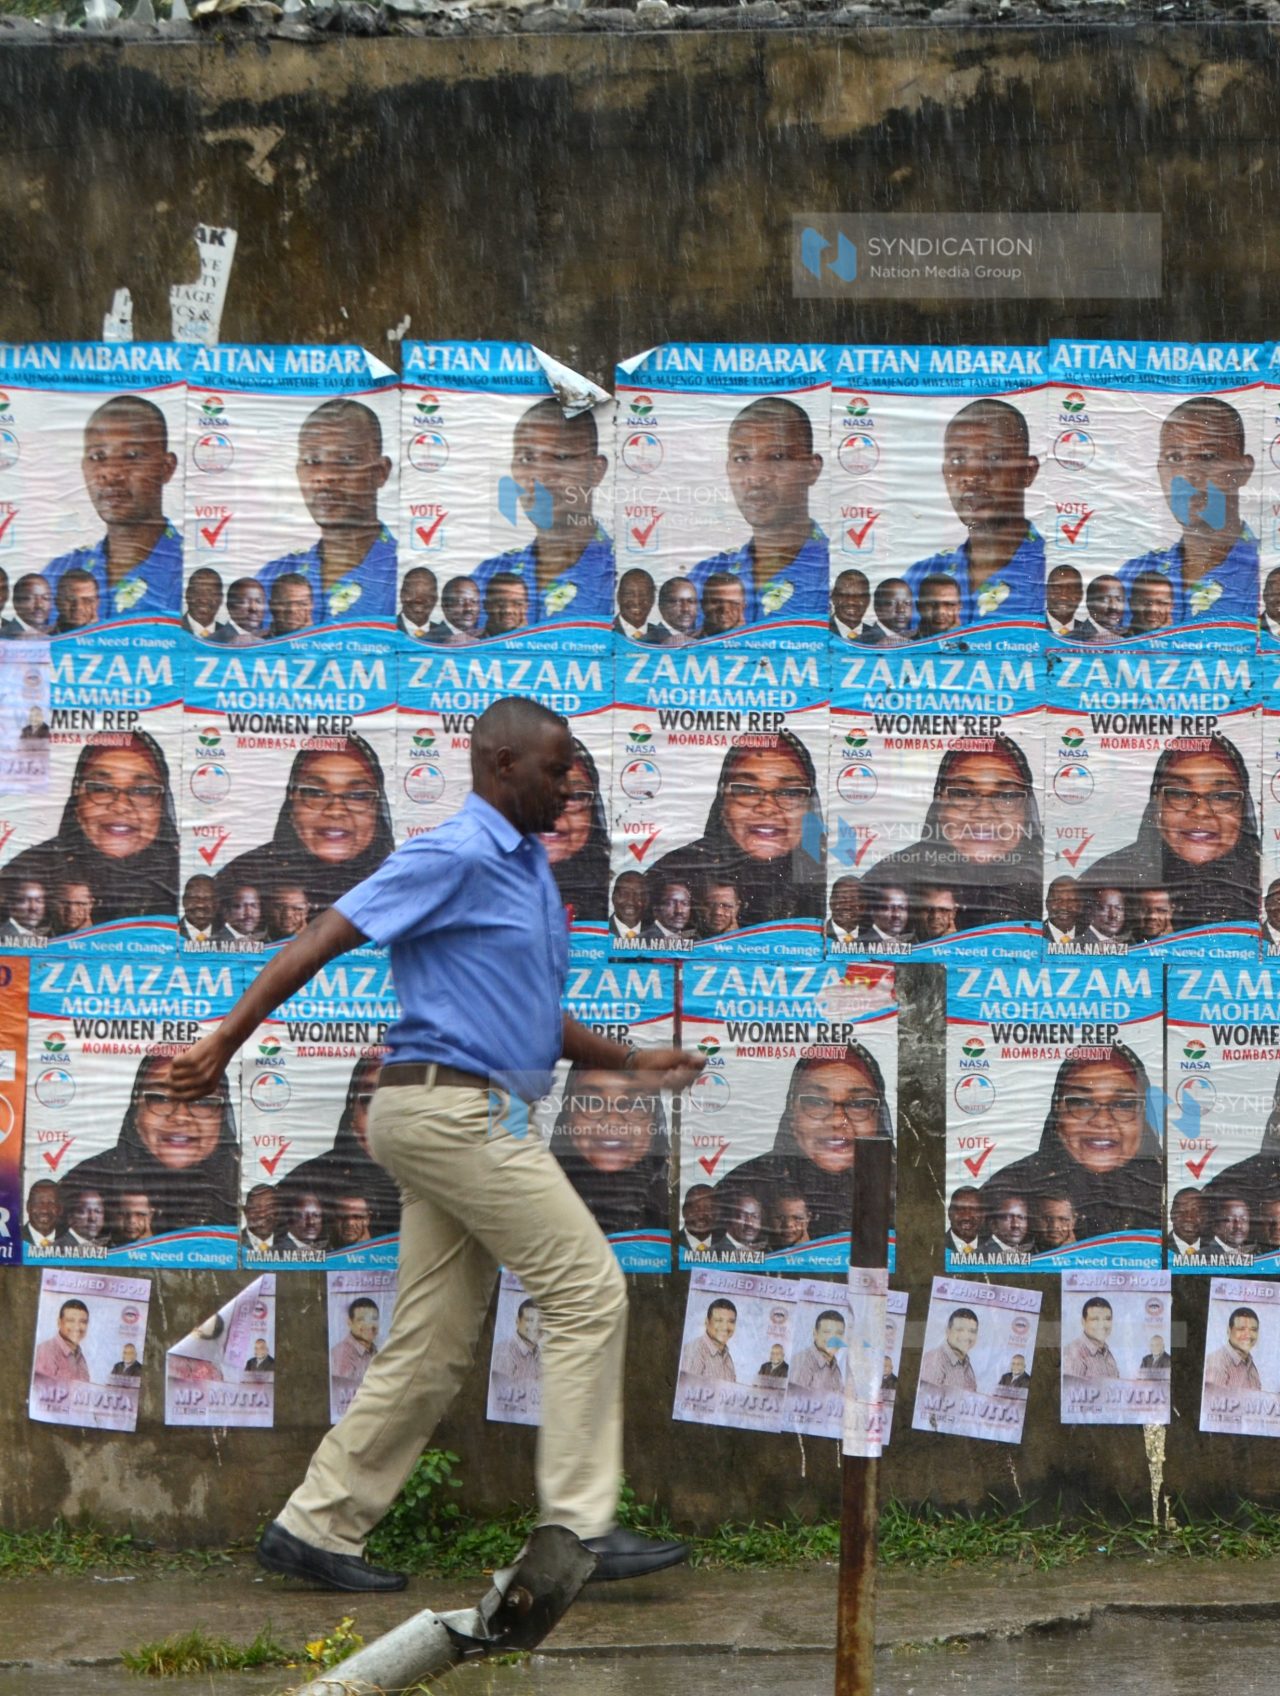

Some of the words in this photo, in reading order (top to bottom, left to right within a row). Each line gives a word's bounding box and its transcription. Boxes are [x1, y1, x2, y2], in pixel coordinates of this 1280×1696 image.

[70, 347, 183, 371] MBARAK
[192, 348, 275, 373] ATTAN
[407, 346, 490, 371] ATTAN
[714, 348, 827, 372] MBARAK
[836, 349, 919, 374] ATTAN
[930, 350, 1043, 374] MBARAK
[1053, 344, 1136, 369] ATTAN
[1147, 348, 1260, 372] MBARAK
[413, 416, 444, 424] NASA
[195, 506, 226, 517] VOTE
[192, 657, 387, 691] ZAMZAM
[624, 653, 819, 687] ZAMZAM
[840, 657, 1035, 691] ZAMZAM
[214, 690, 365, 710] MOHAMMED
[646, 687, 797, 707] MOHAMMED
[862, 692, 1013, 712] MOHAMMED
[227, 713, 309, 734] WOMEN
[317, 714, 357, 736] REP.
[658, 709, 740, 730] WOMEN
[749, 711, 789, 733] REP.
[1090, 713, 1172, 734] WOMEN
[1182, 715, 1222, 737] REP.
[626, 745, 656, 753] NASA
[668, 733, 727, 745] MOMBASA
[732, 735, 779, 747] COUNTY
[1101, 737, 1160, 749] MOMBASA
[1165, 739, 1212, 751] COUNTY
[624, 823, 655, 834] VOTE
[932, 948, 951, 957] We
[955, 948, 988, 957] Need
[992, 948, 1038, 958] Change
[38, 963, 233, 997] ZAMZAM
[956, 966, 1151, 1000] ZAMZAM
[60, 996, 211, 1016] MOHAMMED
[979, 1000, 1130, 1020] MOHAMMED
[72, 1018, 154, 1039] WOMEN
[163, 1020, 203, 1042] REP.
[991, 1022, 1073, 1043] WOMEN
[1082, 1023, 1122, 1045] REP.
[41, 1054, 71, 1062] NASA
[1001, 1046, 1060, 1058] MOMBASA
[1066, 1048, 1113, 1060] COUNTY
[960, 1060, 990, 1068] NASA
[959, 1138, 990, 1149] VOTE
[1052, 1259, 1071, 1268] We
[1075, 1257, 1108, 1266] Need
[1112, 1257, 1158, 1267] Change
[37, 1387, 69, 1403] MP
[922, 1394, 955, 1413] MP
[1069, 1387, 1100, 1403] MP
